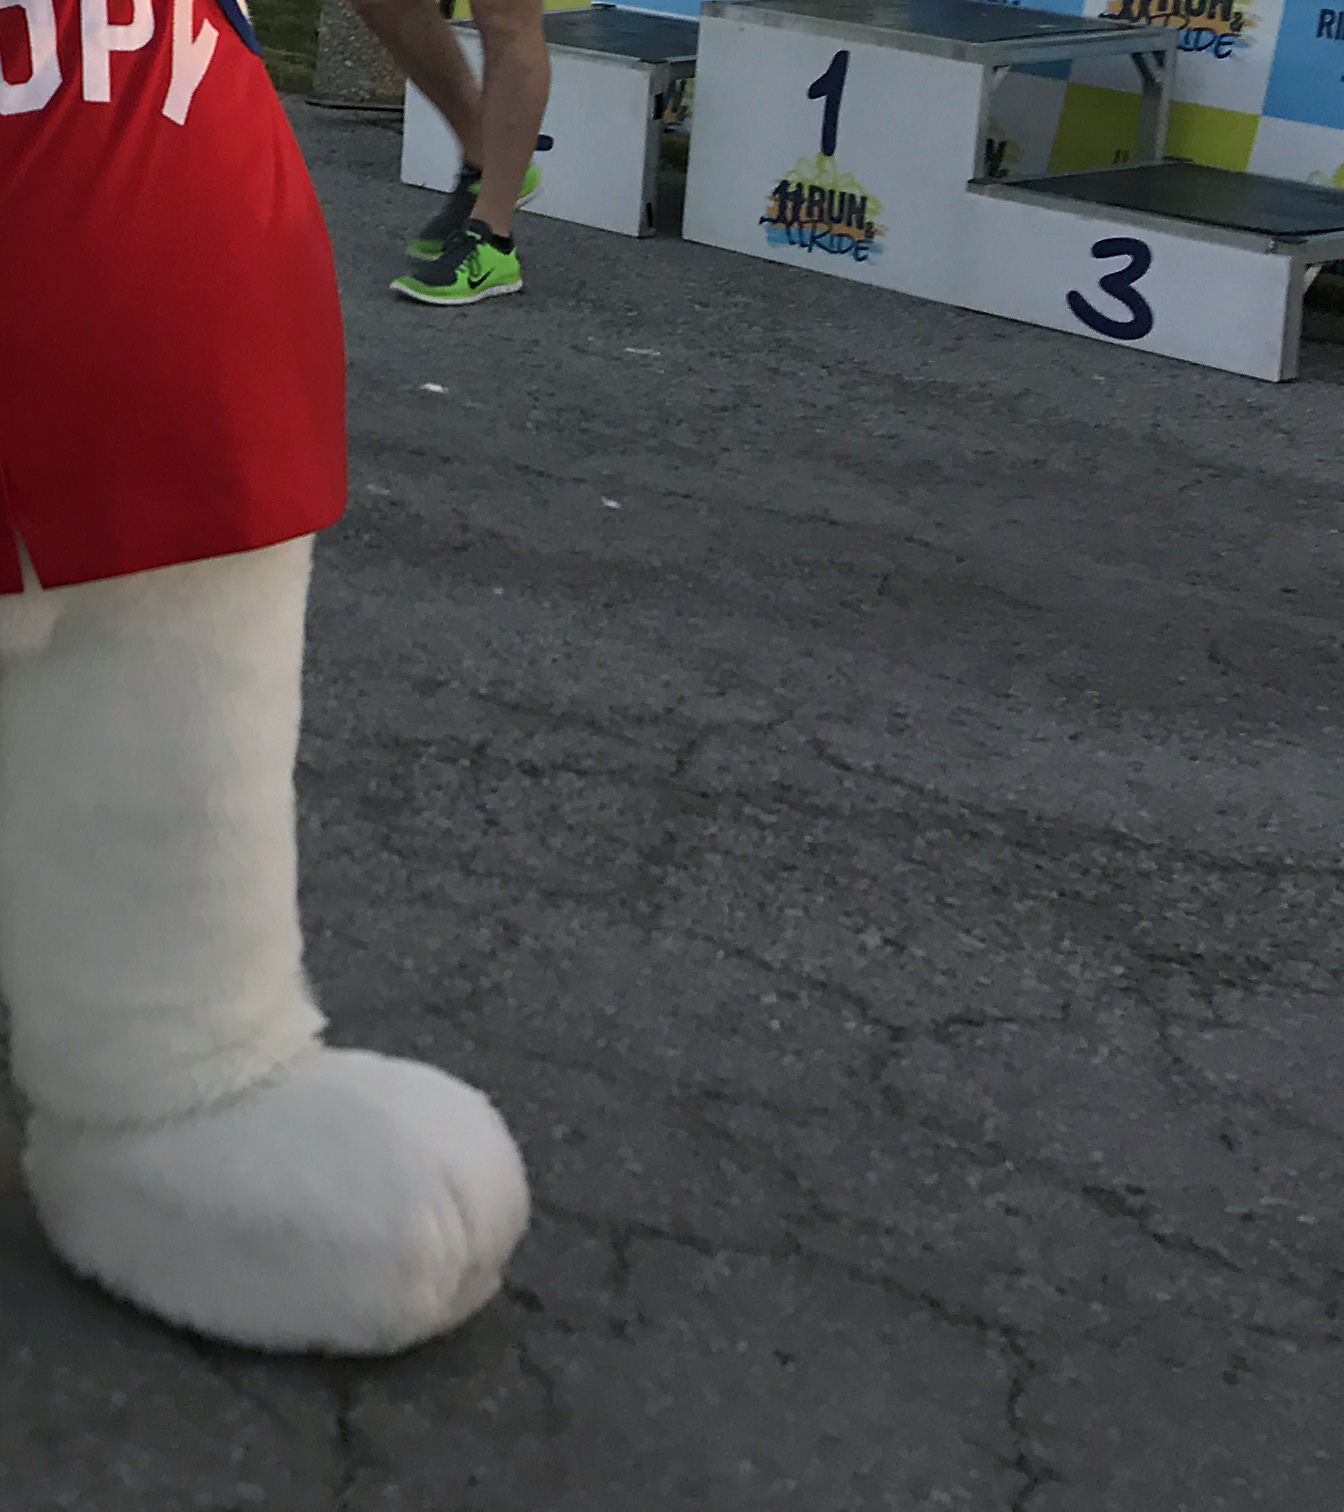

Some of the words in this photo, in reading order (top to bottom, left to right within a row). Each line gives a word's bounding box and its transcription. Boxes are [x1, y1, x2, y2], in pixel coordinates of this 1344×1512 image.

[807, 50, 850, 157] 1
[805, 184, 869, 230] RUN
[806, 218, 873, 262] RIDE
[1066, 237, 1152, 341] 3
